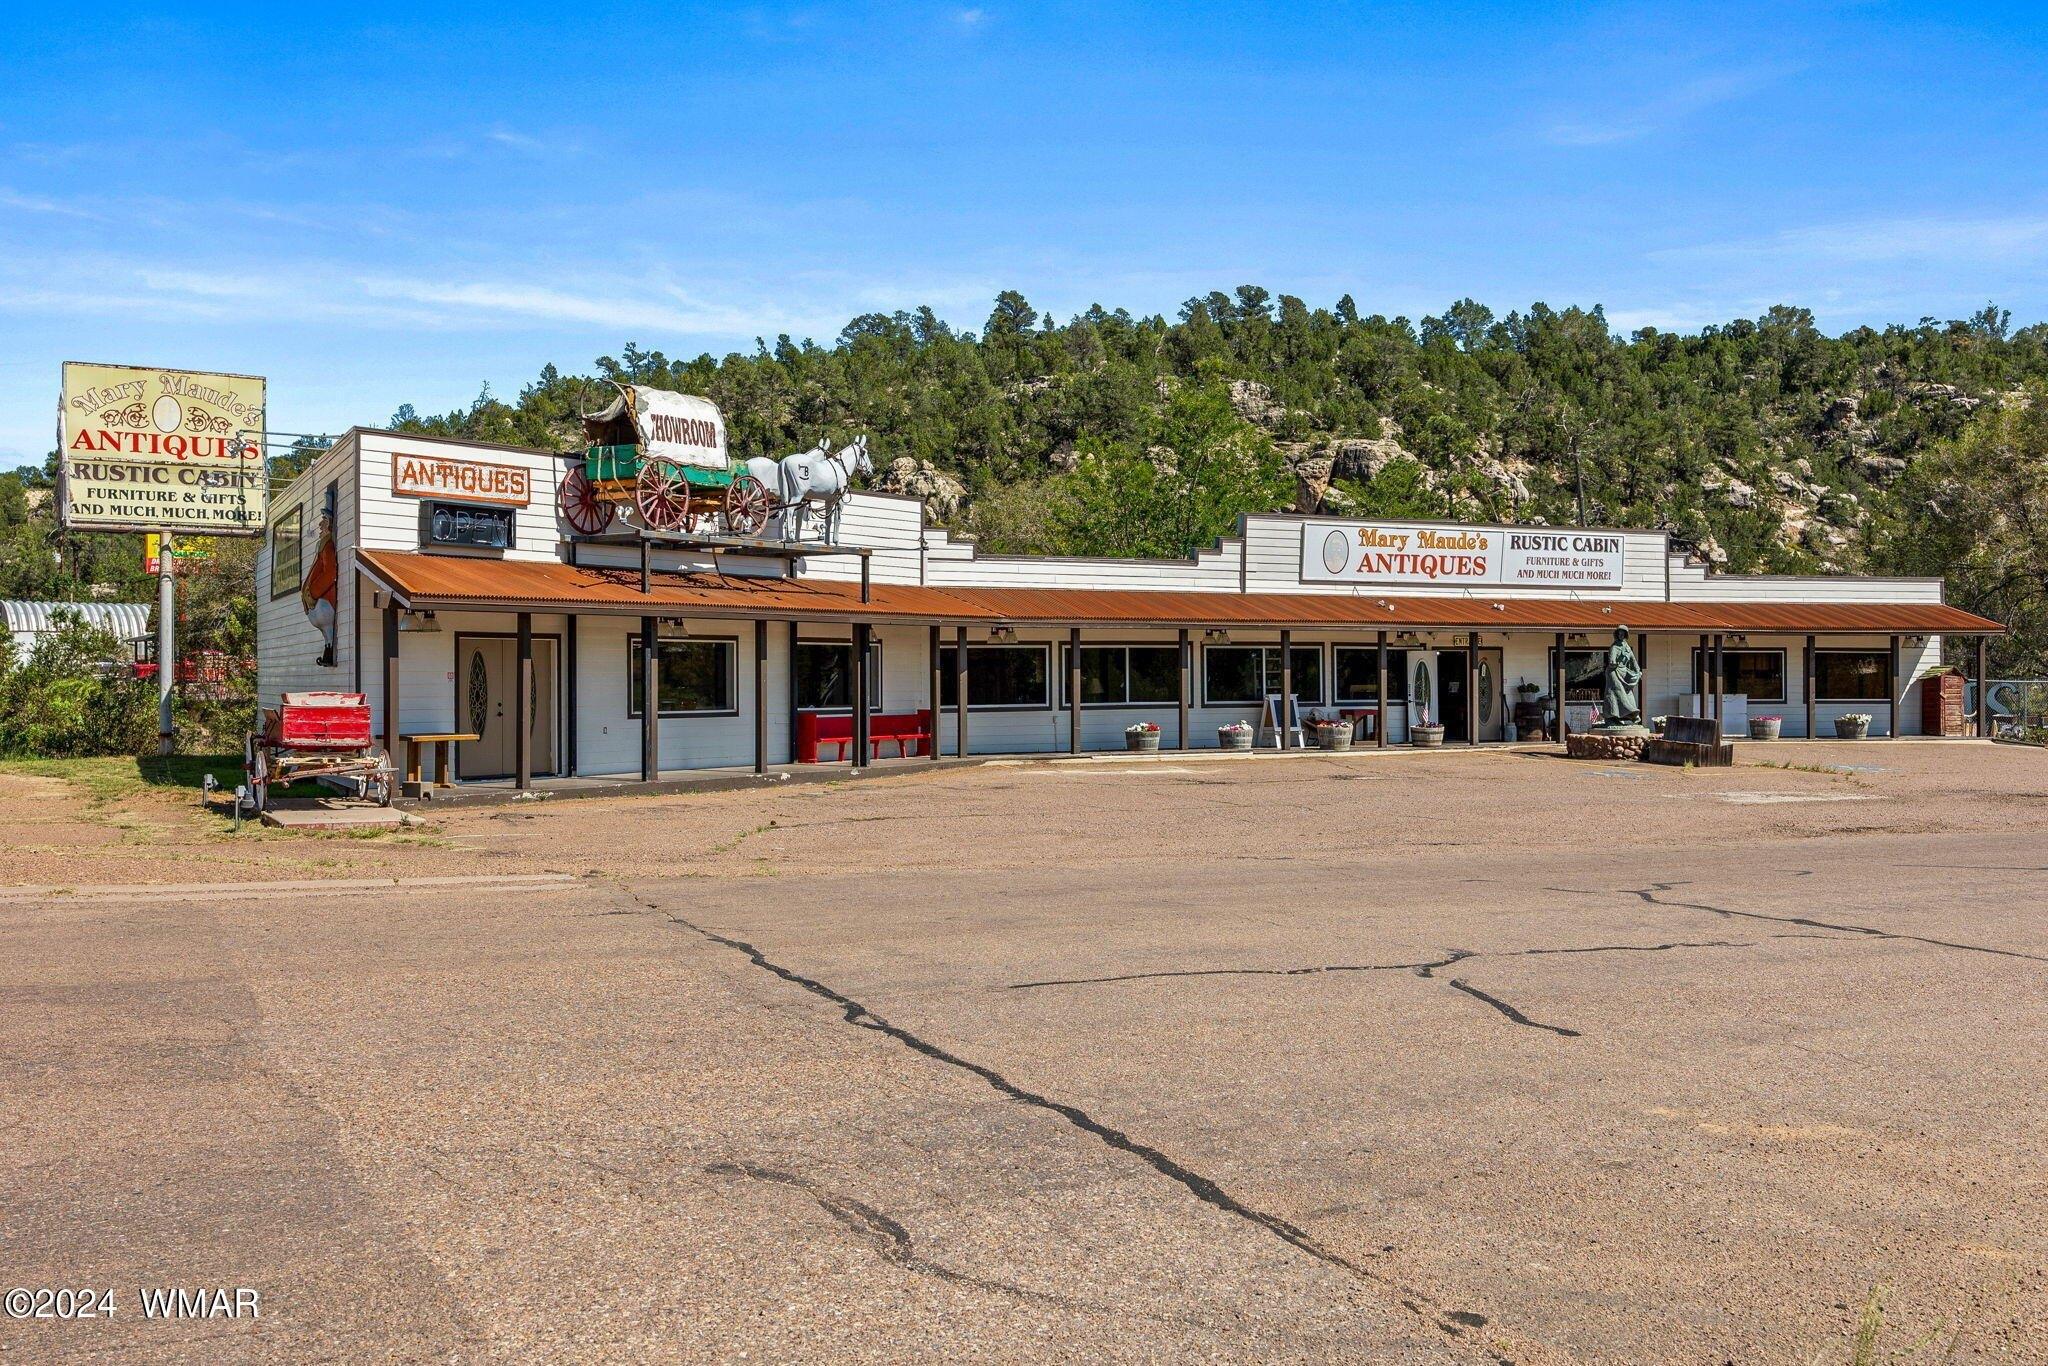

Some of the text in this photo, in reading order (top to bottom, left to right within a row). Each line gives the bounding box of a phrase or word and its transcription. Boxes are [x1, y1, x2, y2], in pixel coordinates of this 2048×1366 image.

[71, 373, 260, 427] Mary Maude's
[71, 429, 259, 461] ANTIQUES
[74, 462, 257, 488] RUSTIC CABIN
[401, 460, 525, 495] ANTIQUES
[87, 487, 247, 506] FURNITURE & GIFTS
[69, 503, 262, 521] AND MUCH, MUCH, MORE!
[1358, 528, 1488, 552] Mary Maude's
[1510, 535, 1620, 553] RUSTIC CABIN
[1356, 553, 1487, 579] ANTIQUES
[1526, 556, 1604, 567] FURNITURE & GIFTS
[1517, 569, 1611, 580] AND MUCH MUCH MORE!
